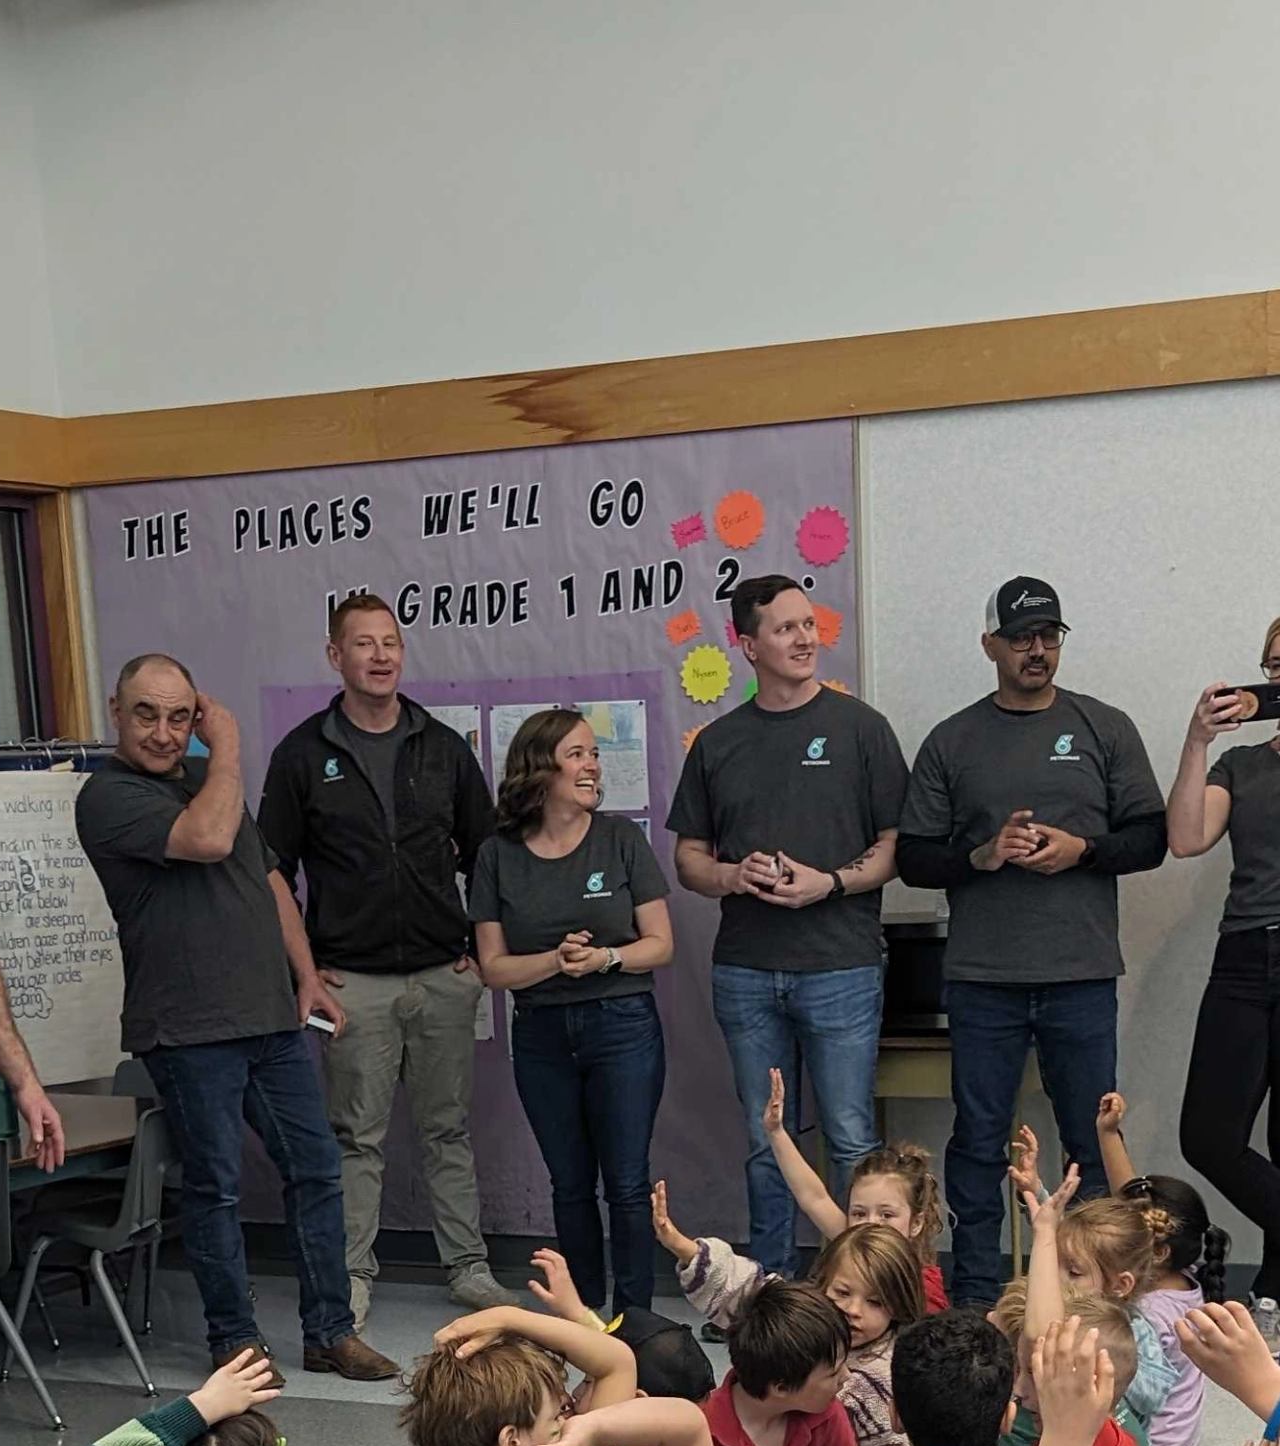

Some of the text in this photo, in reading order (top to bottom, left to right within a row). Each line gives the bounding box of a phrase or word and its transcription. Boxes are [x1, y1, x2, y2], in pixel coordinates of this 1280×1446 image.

[122, 477, 646, 563] THE PLACES WE'LL GO
[325, 556, 742, 638] I GRADE 1 AND 2
